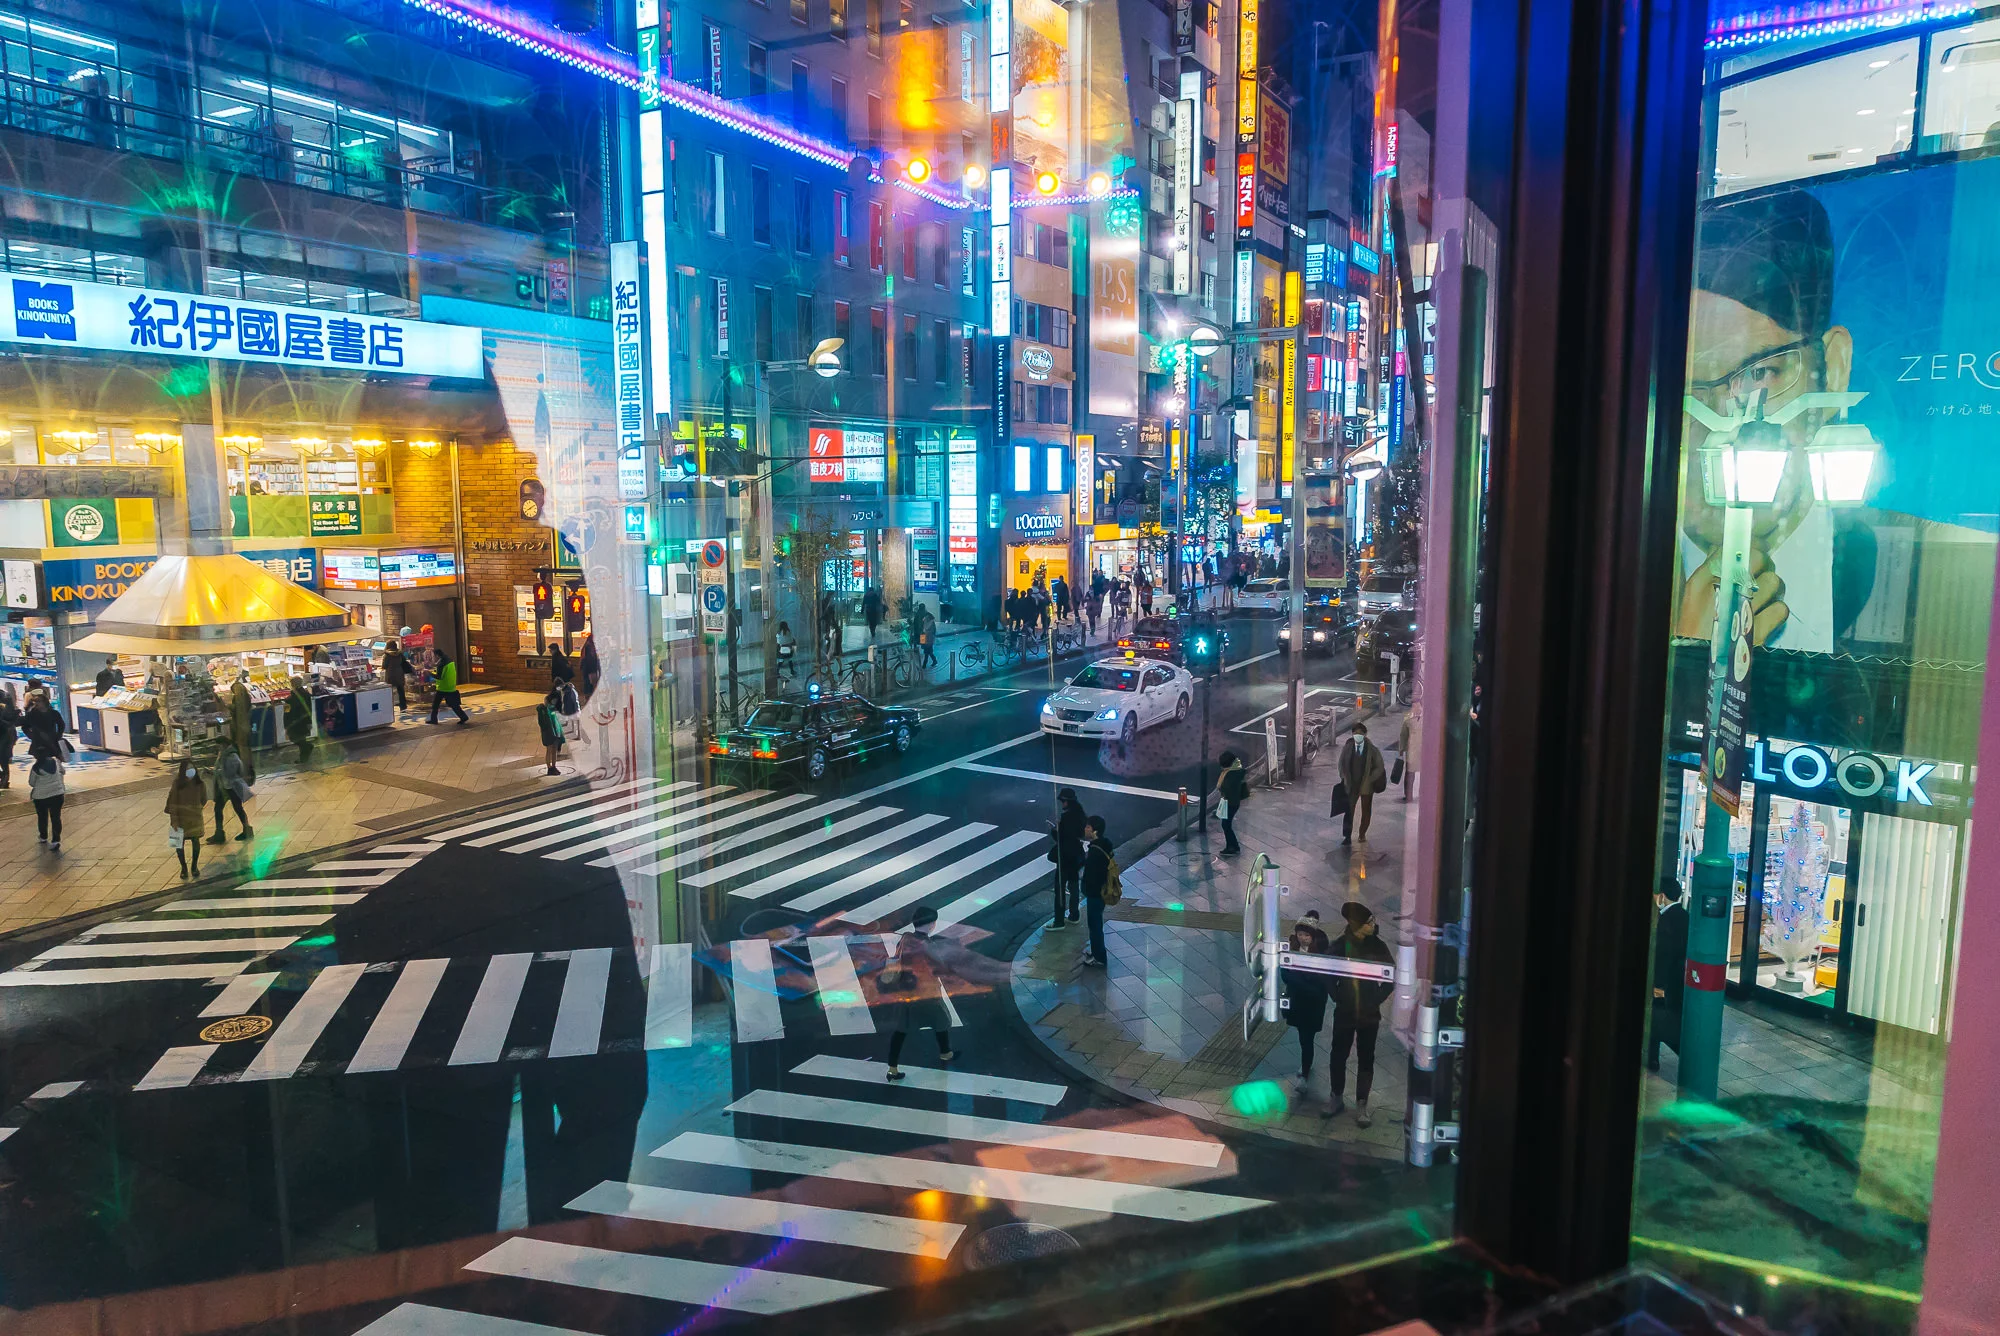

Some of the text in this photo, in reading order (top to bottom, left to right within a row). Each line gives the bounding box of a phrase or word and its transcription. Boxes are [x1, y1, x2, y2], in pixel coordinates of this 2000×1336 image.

[1241, 134, 1254, 142] 9F
[1240, 176, 1252, 216] ガスト
[28, 298, 59, 312] BOOKS
[17, 309, 72, 326] KINOKUNIYA
[129, 294, 403, 367] 紀伊國屋書店
[615, 280, 643, 461] 紀伊國屋書店
[1285, 352, 1293, 406] Matsumoto
[312, 501, 357, 512] 紀伊茶屋
[1016, 514, 1063, 530] L'OCCITANE
[708, 592, 717, 608] P
[240, 624, 272, 636] BOOKS
[1754, 741, 1935, 806] LOOK
